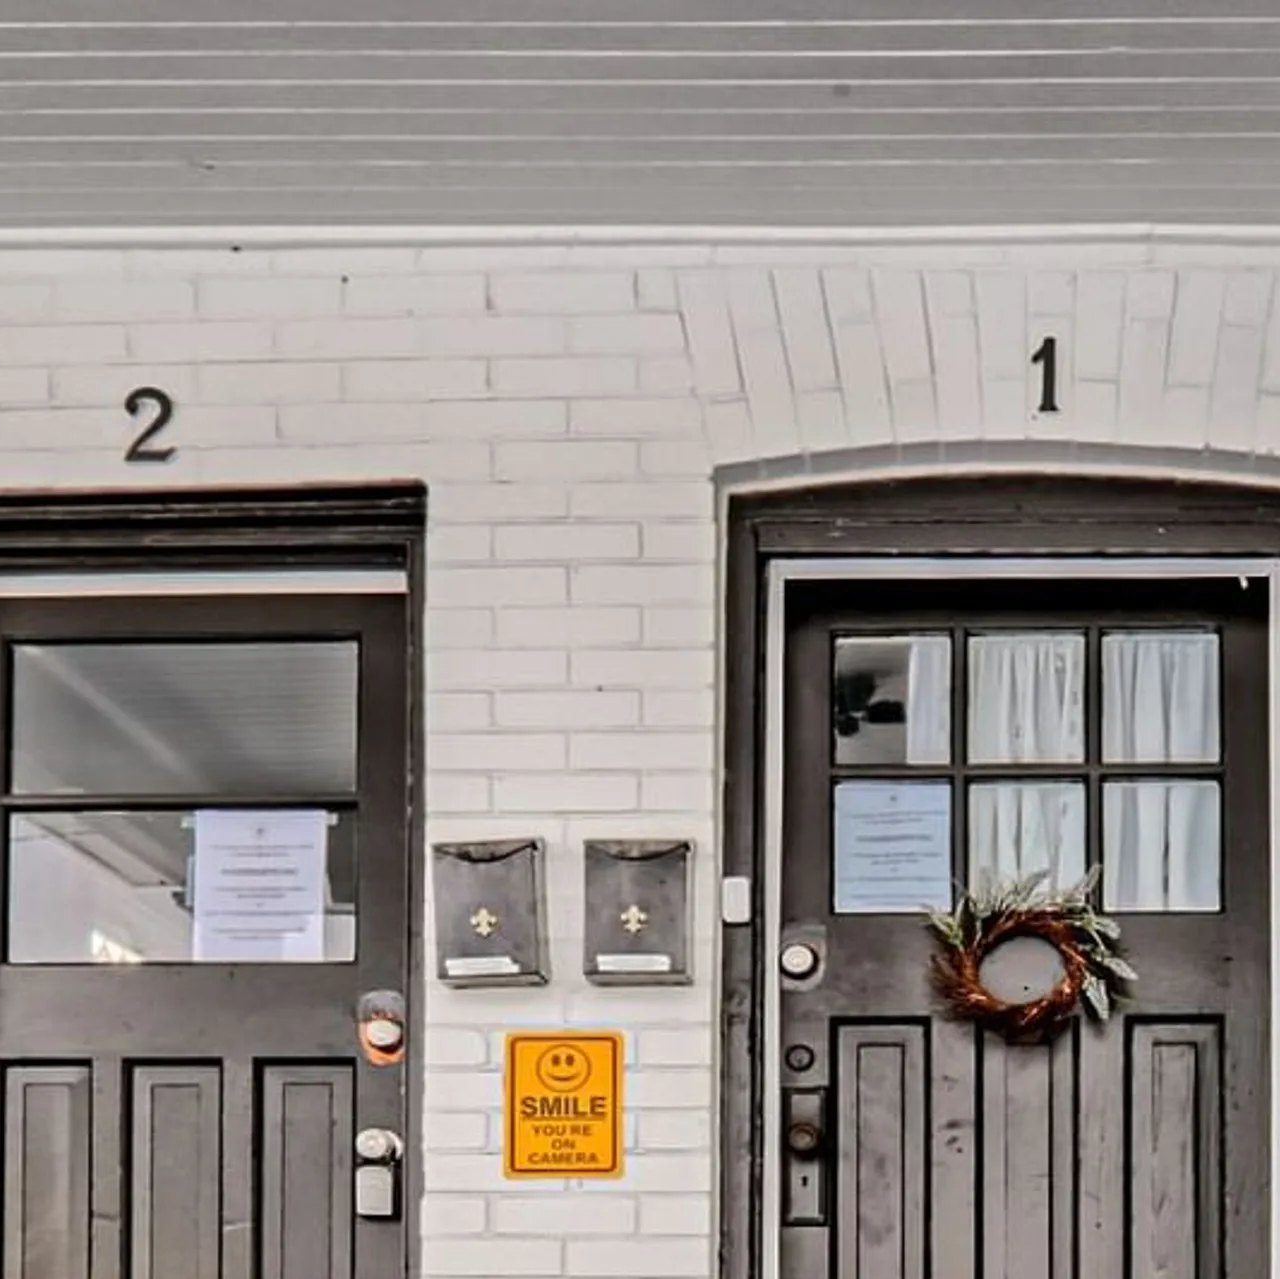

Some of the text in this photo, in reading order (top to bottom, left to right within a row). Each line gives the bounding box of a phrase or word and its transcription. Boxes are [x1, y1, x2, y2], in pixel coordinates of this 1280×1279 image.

[1031, 336, 1061, 412] 1
[124, 387, 177, 462] 2
[520, 1096, 607, 1117] SMILE
[531, 1124, 593, 1137] YOURE
[551, 1138, 576, 1151] ON
[527, 1151, 600, 1165] CAMERA
